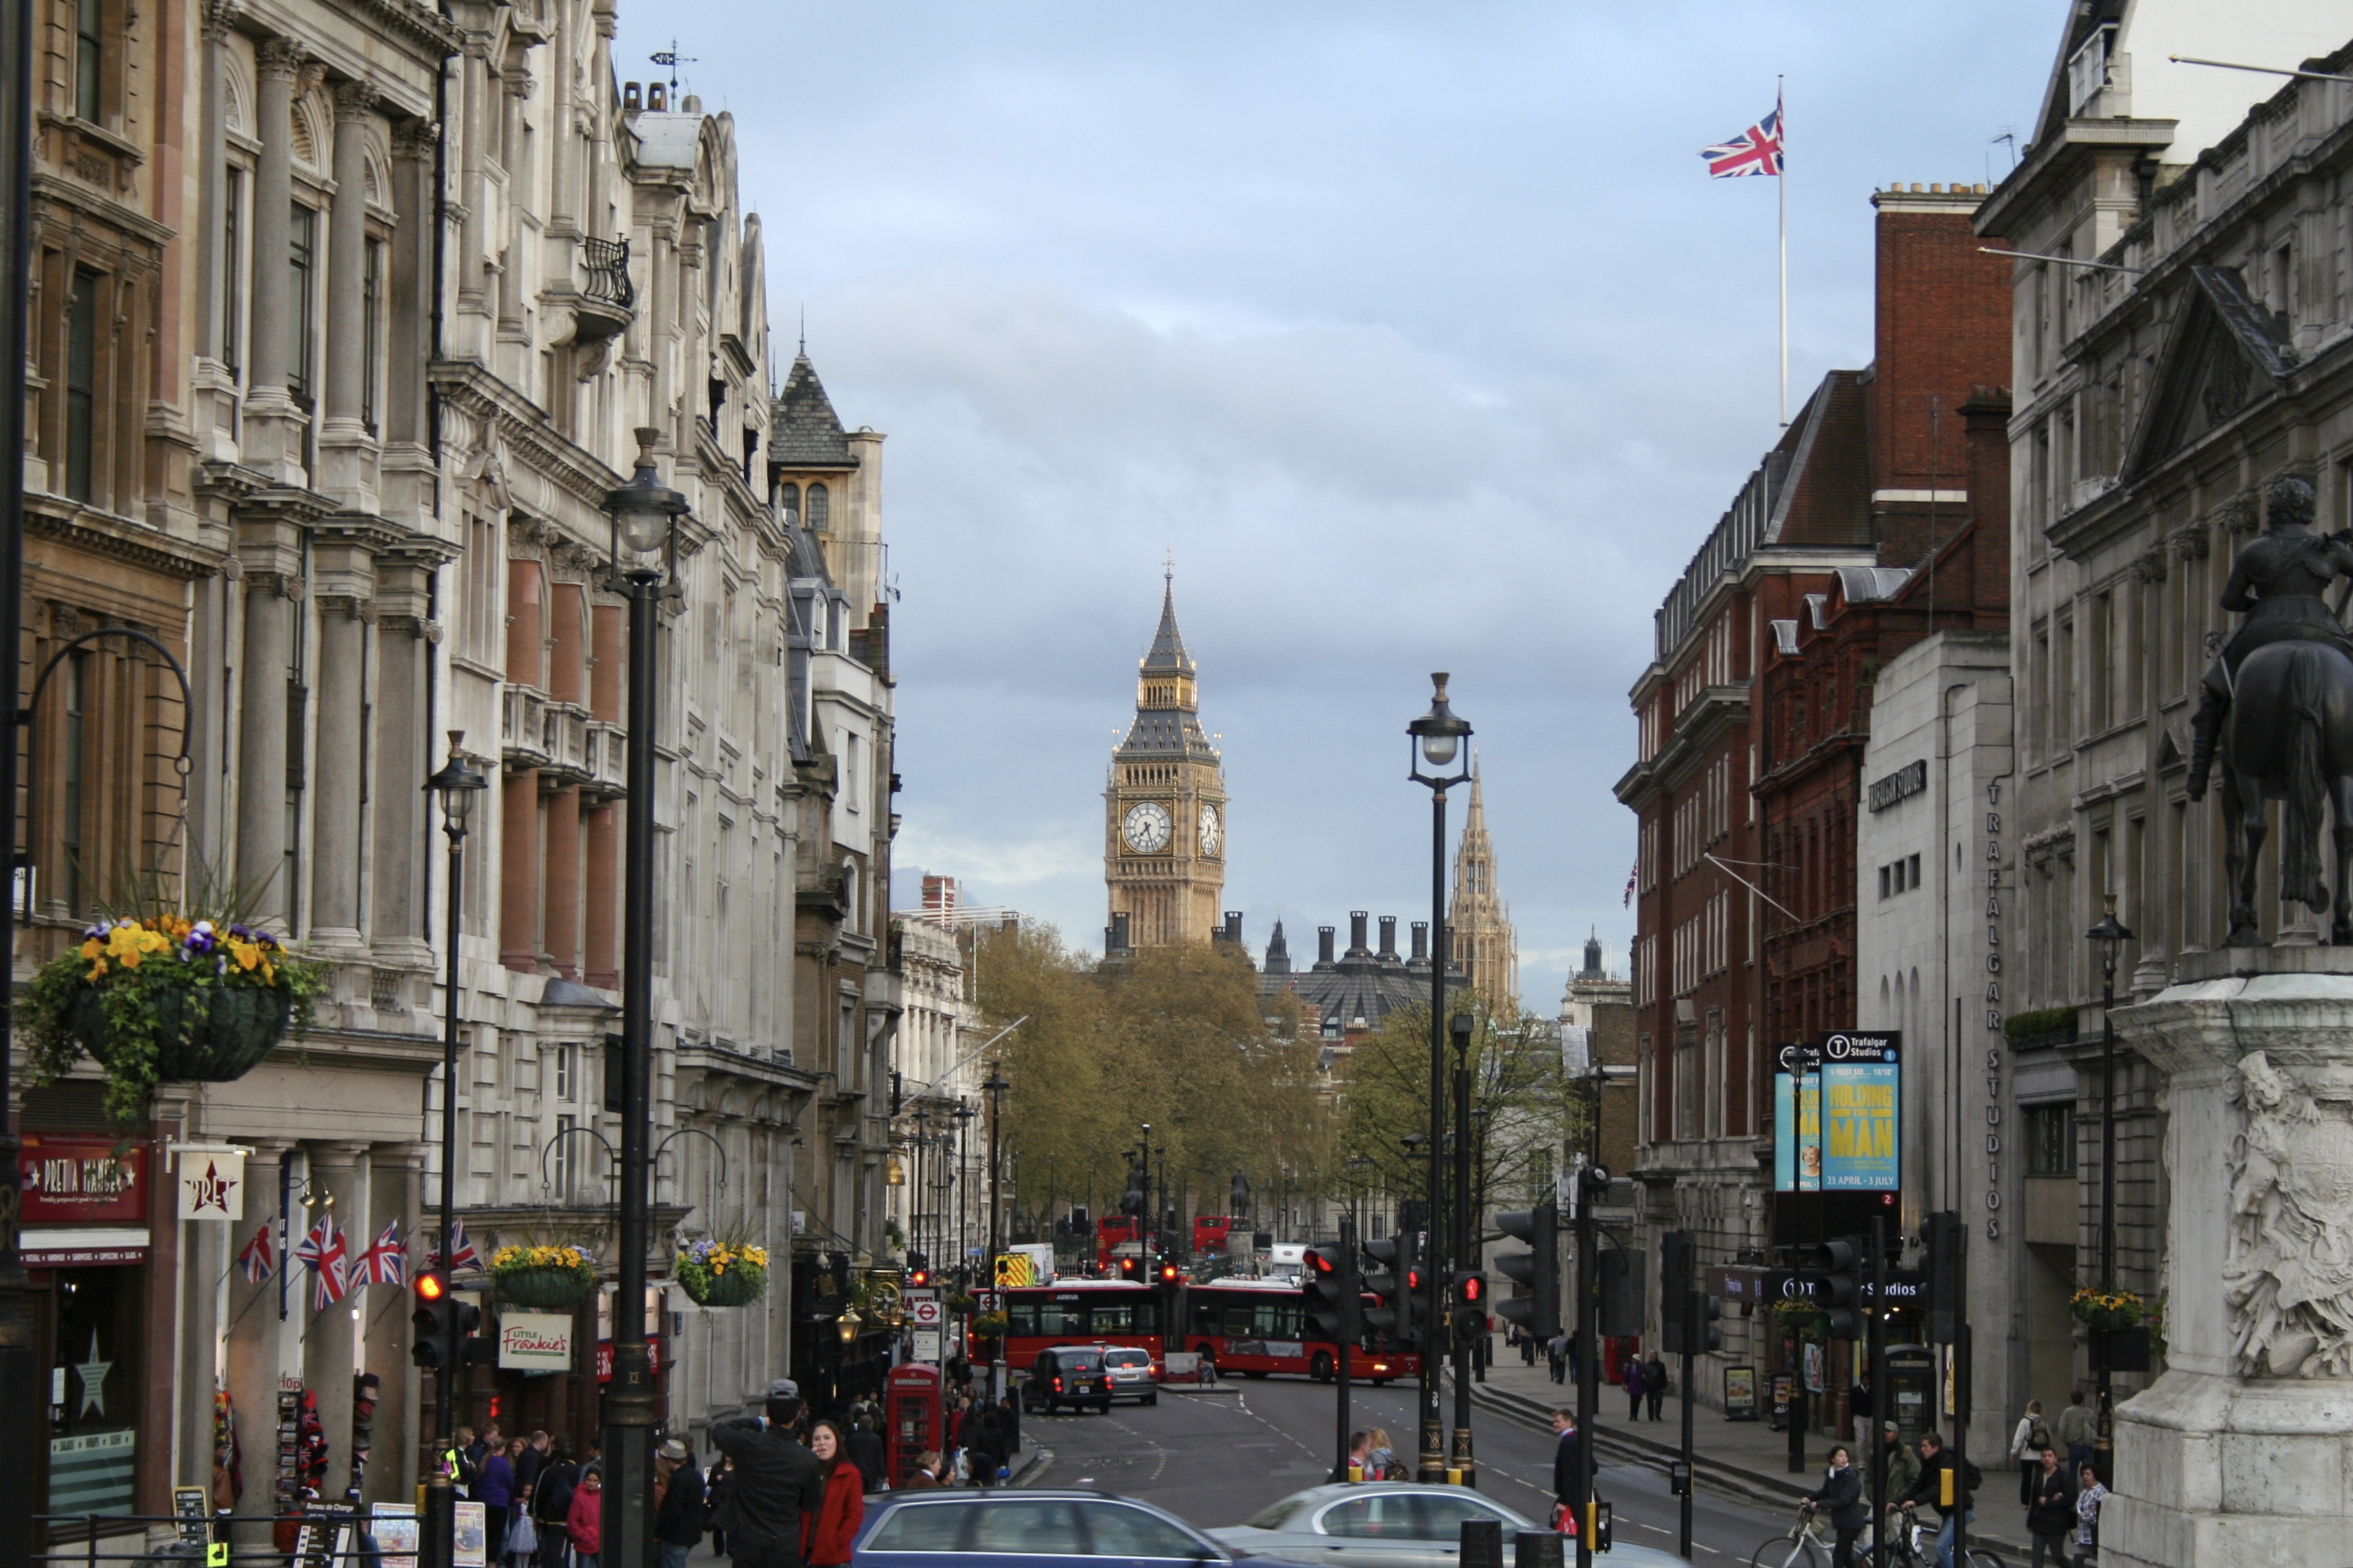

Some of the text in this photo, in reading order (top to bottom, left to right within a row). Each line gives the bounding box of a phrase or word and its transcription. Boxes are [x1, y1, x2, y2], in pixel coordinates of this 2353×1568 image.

[1986, 786, 2000, 1238] TRAFALGAR STUDIOS
[1850, 1037, 1888, 1048] Trafalgar
[1850, 1047, 1881, 1057] Studios
[1829, 1084, 1893, 1108] HOLDING
[1852, 1108, 1868, 1117] THE
[1829, 1118, 1893, 1159] MAN
[45, 1159, 68, 1192] PRET
[1827, 1176, 1836, 1185] 23
[1838, 1176, 1862, 1185] APRIL
[1869, 1176, 1874, 1185] 3
[1874, 1176, 1895, 1187] JULY
[190, 1174, 234, 1206] PRET
[1884, 1195, 1890, 1203] 2
[503, 1326, 567, 1353] Frankie's
[333, 1504, 354, 1513] Change
